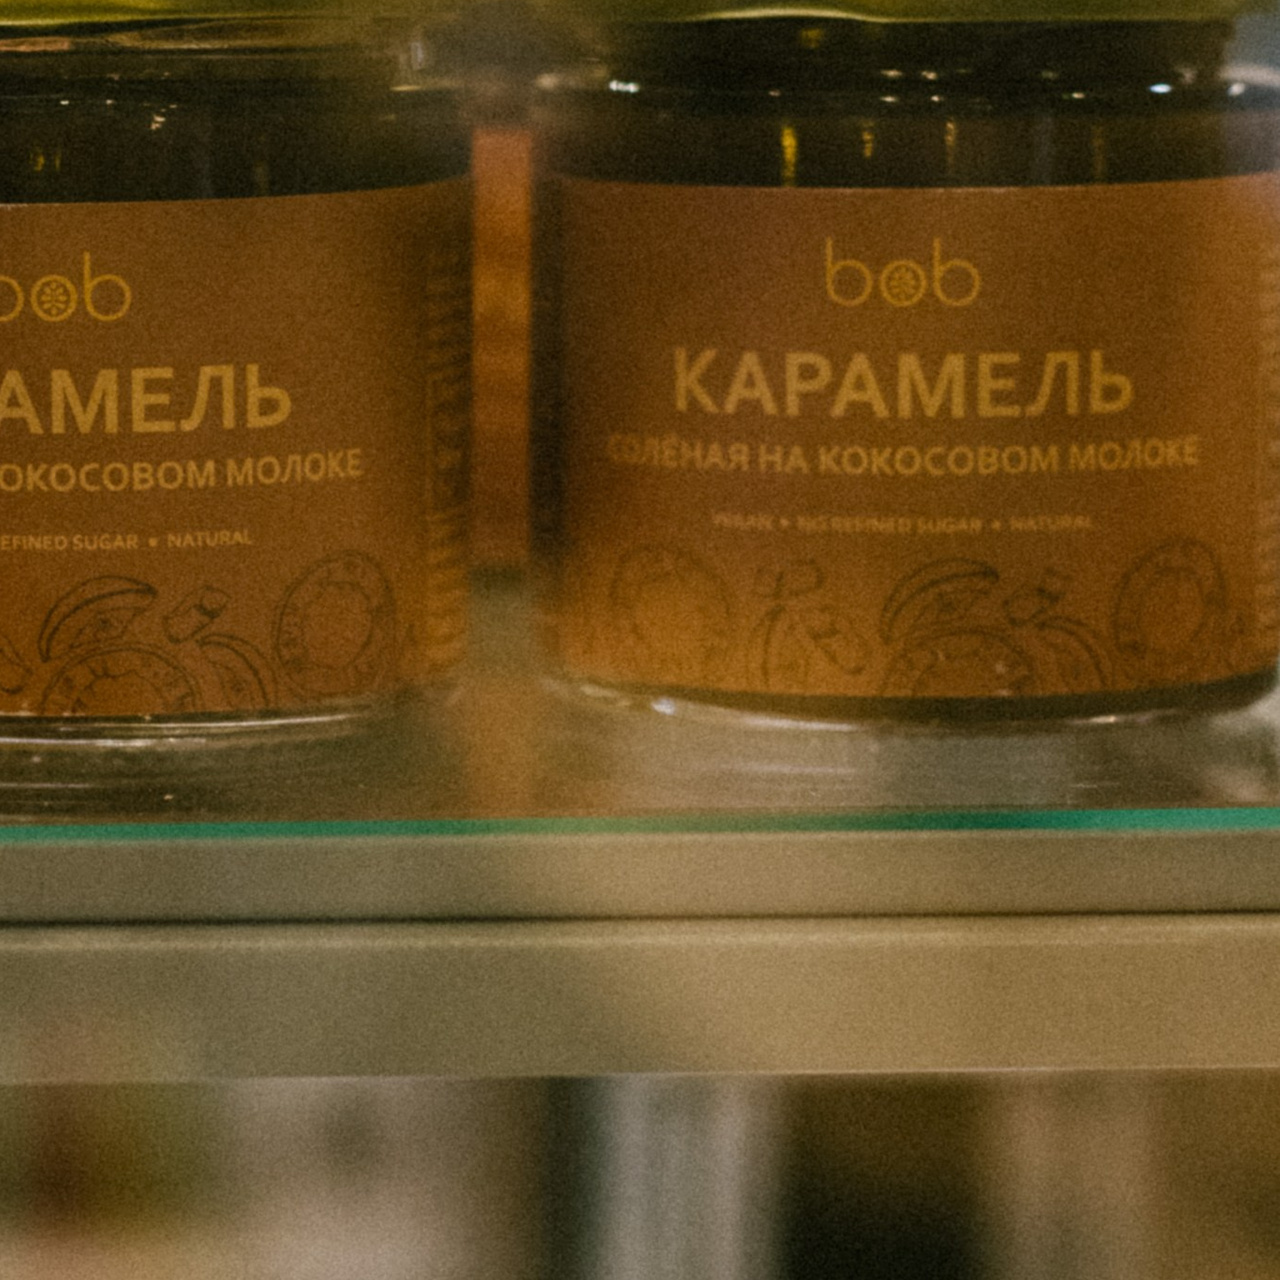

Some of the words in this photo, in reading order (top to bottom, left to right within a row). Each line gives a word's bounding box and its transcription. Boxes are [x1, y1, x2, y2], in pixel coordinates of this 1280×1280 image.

[825, 237, 982, 307] bob
[673, 346, 1134, 420] КАРАМЕЛЬ
[226, 448, 362, 485] МОЛОКЕ
[606, 431, 750, 472] СОЛЁНАЯ
[759, 443, 809, 473] НА
[819, 444, 1060, 476] КОКОСОВОМ
[1070, 434, 1199, 471] МОЛОКЕ
[72, 532, 139, 550] SUGAR
[167, 528, 253, 548] NATURAL
